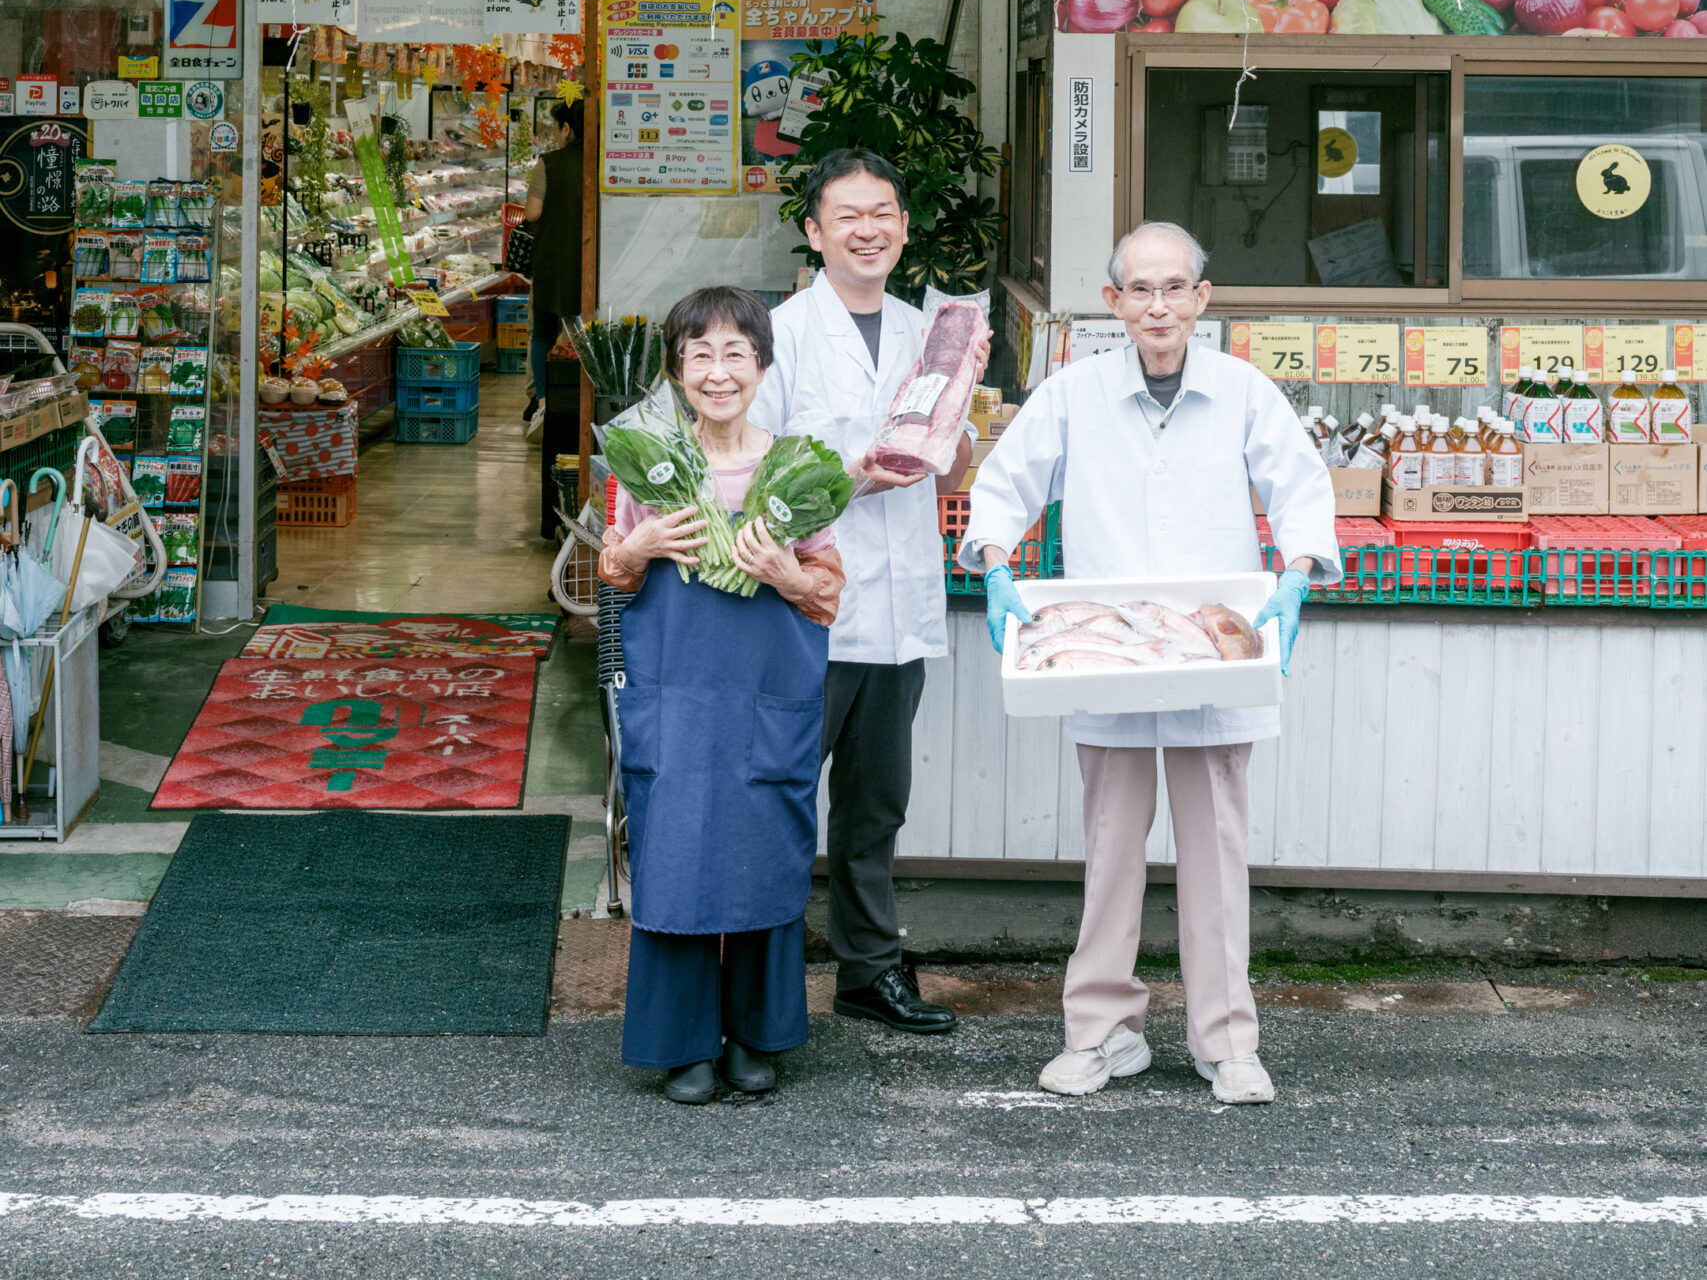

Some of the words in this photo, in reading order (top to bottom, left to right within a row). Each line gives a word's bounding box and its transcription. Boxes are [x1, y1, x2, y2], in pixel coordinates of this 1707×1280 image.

[745, 7, 872, 26] 全ちゃんアプリ
[628, 47, 648, 55] VISA
[169, 57, 237, 68] 全日食チェーン
[104, 100, 129, 108] トクバイ
[142, 95, 180, 105] 取扱店
[1073, 81, 1089, 169] 防犯カメラ設置
[1272, 352, 1304, 370] 75
[1358, 355, 1391, 372] 75
[1447, 358, 1479, 376] 75
[1532, 355, 1574, 374] 129
[1616, 355, 1658, 373] 129
[1344, 490, 1375, 499] むぎ茶
[249, 667, 505, 683] 生鮮食品の
[250, 681, 493, 699] おいしい店
